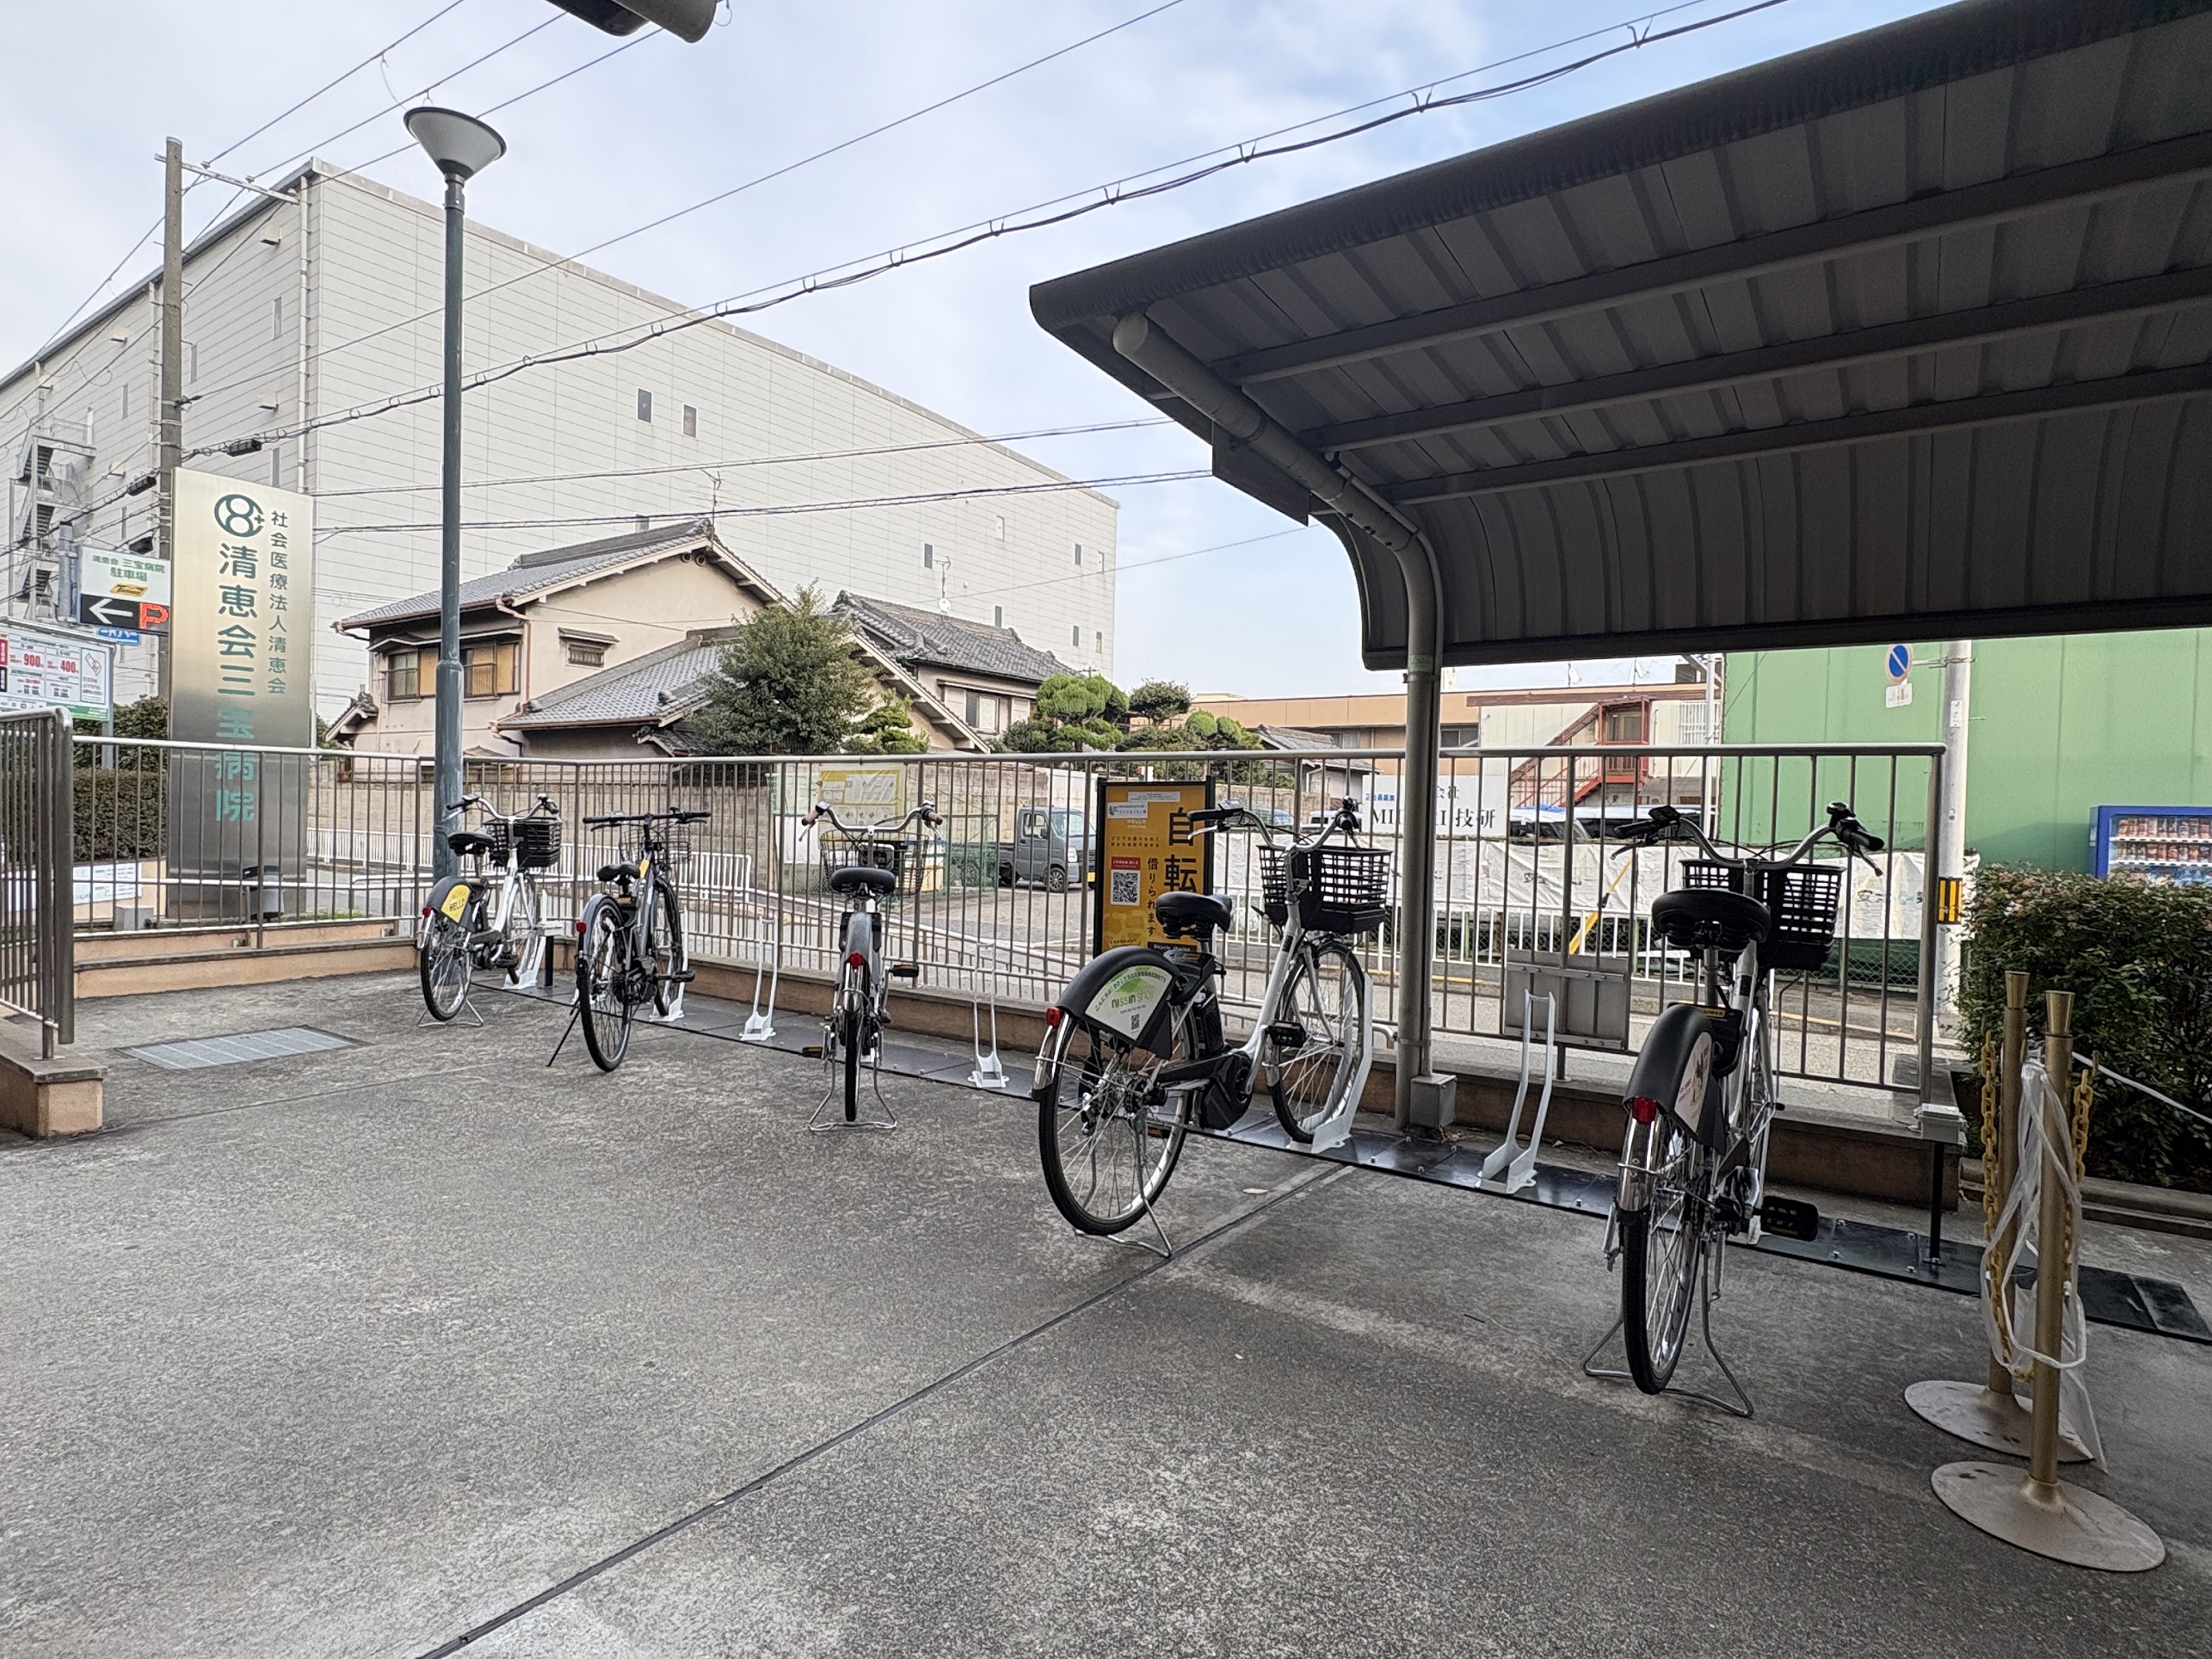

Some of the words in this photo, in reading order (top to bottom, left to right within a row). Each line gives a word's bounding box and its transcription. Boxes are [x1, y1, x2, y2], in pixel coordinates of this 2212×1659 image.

[110, 567, 148, 582] 駐車場
[268, 510, 288, 694] 社会医療法人清恵会
[139, 602, 169, 629] P
[216, 542, 259, 822] 清恵会三宝病院
[1147, 857, 1159, 937] 借りられます
